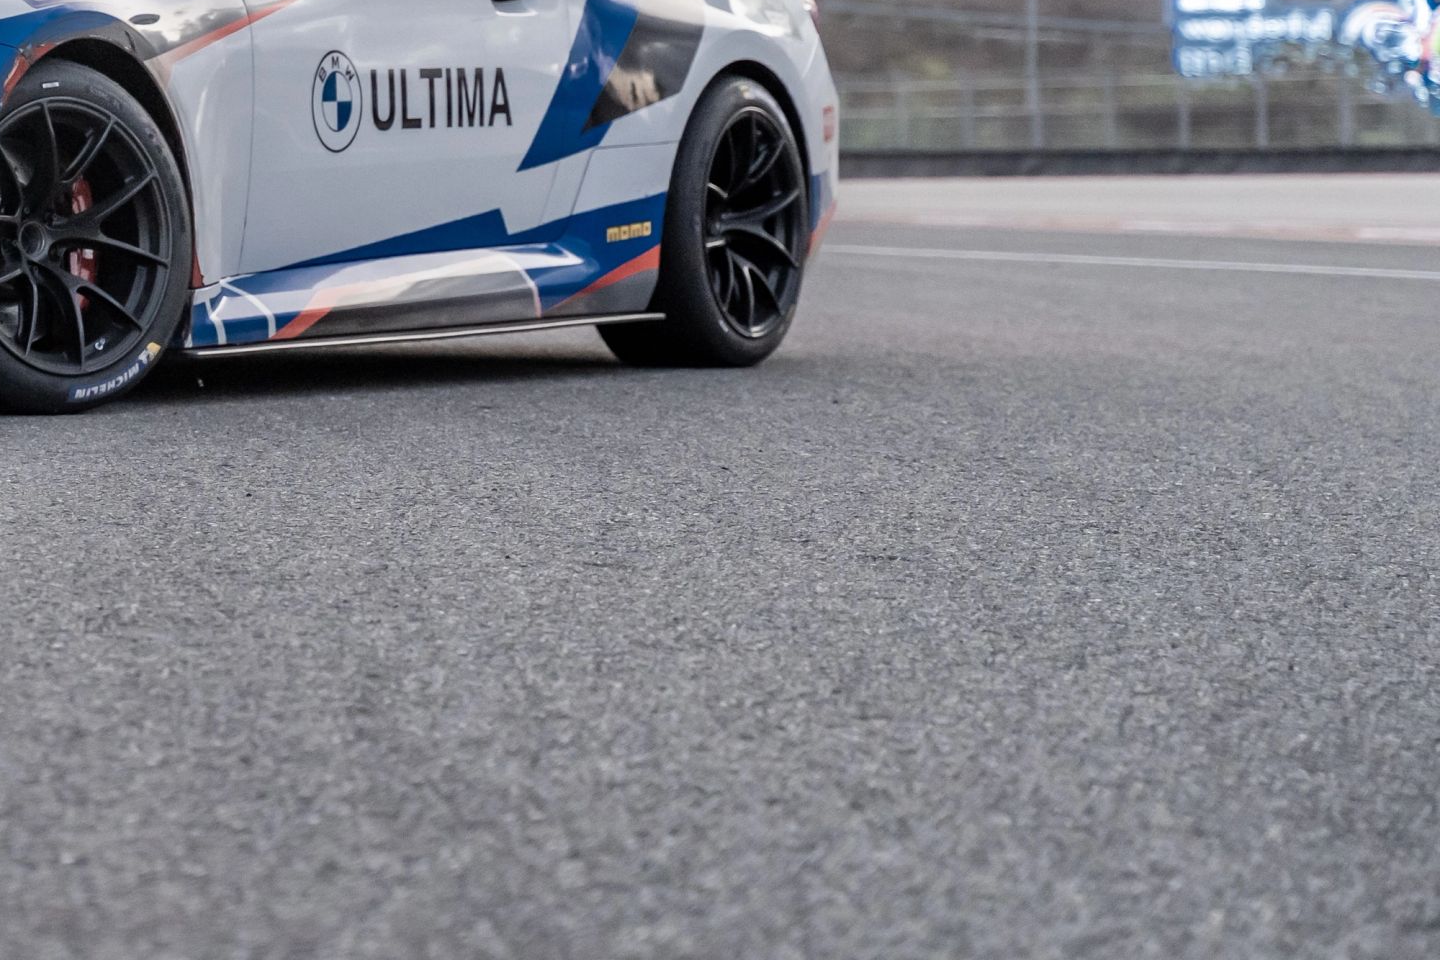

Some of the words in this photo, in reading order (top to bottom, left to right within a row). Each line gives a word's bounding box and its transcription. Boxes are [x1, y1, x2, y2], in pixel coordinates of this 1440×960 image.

[318, 55, 355, 82] BMW
[370, 67, 513, 131] ULTIMA
[607, 221, 651, 243] momo
[74, 363, 140, 399] MICHELIN
